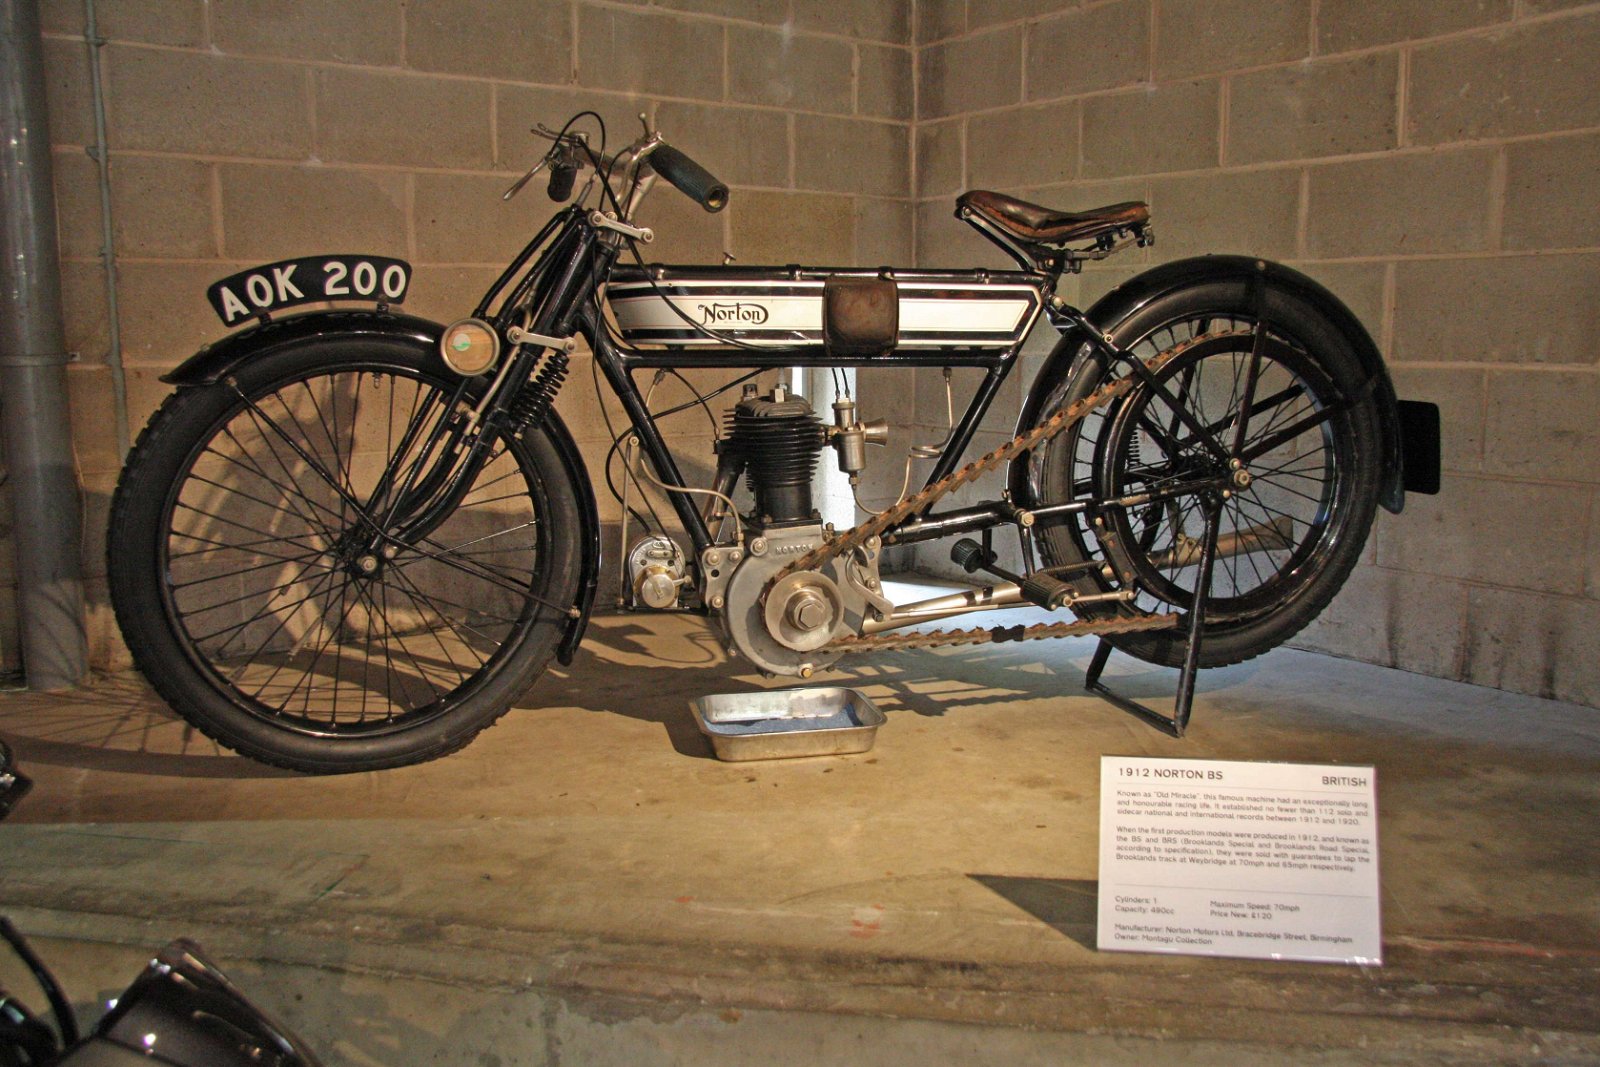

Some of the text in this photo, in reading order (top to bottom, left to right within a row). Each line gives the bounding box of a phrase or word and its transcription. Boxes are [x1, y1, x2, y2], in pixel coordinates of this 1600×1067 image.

[220, 261, 406, 322] AOK 200
[698, 302, 769, 325] Norton
[1119, 767, 1223, 779] 1912 NORTON BS
[1322, 776, 1367, 787] BRITISH
[1174, 802, 1196, 810] racing
[1303, 798, 1349, 807] exceptionally
[1166, 828, 1204, 837] production
[1252, 832, 1286, 841] produced
[1228, 840, 1253, 848] Special
[1116, 844, 1150, 853] according
[1291, 853, 1330, 862] guarantees
[1189, 857, 1226, 866] Weybridge
[1239, 859, 1264, 868] 70mph
[1273, 903, 1299, 912] 70mph
[1141, 934, 1173, 943] Montagu
[1175, 936, 1212, 944] Collection
[1236, 930, 1280, 940] Bracebridge
